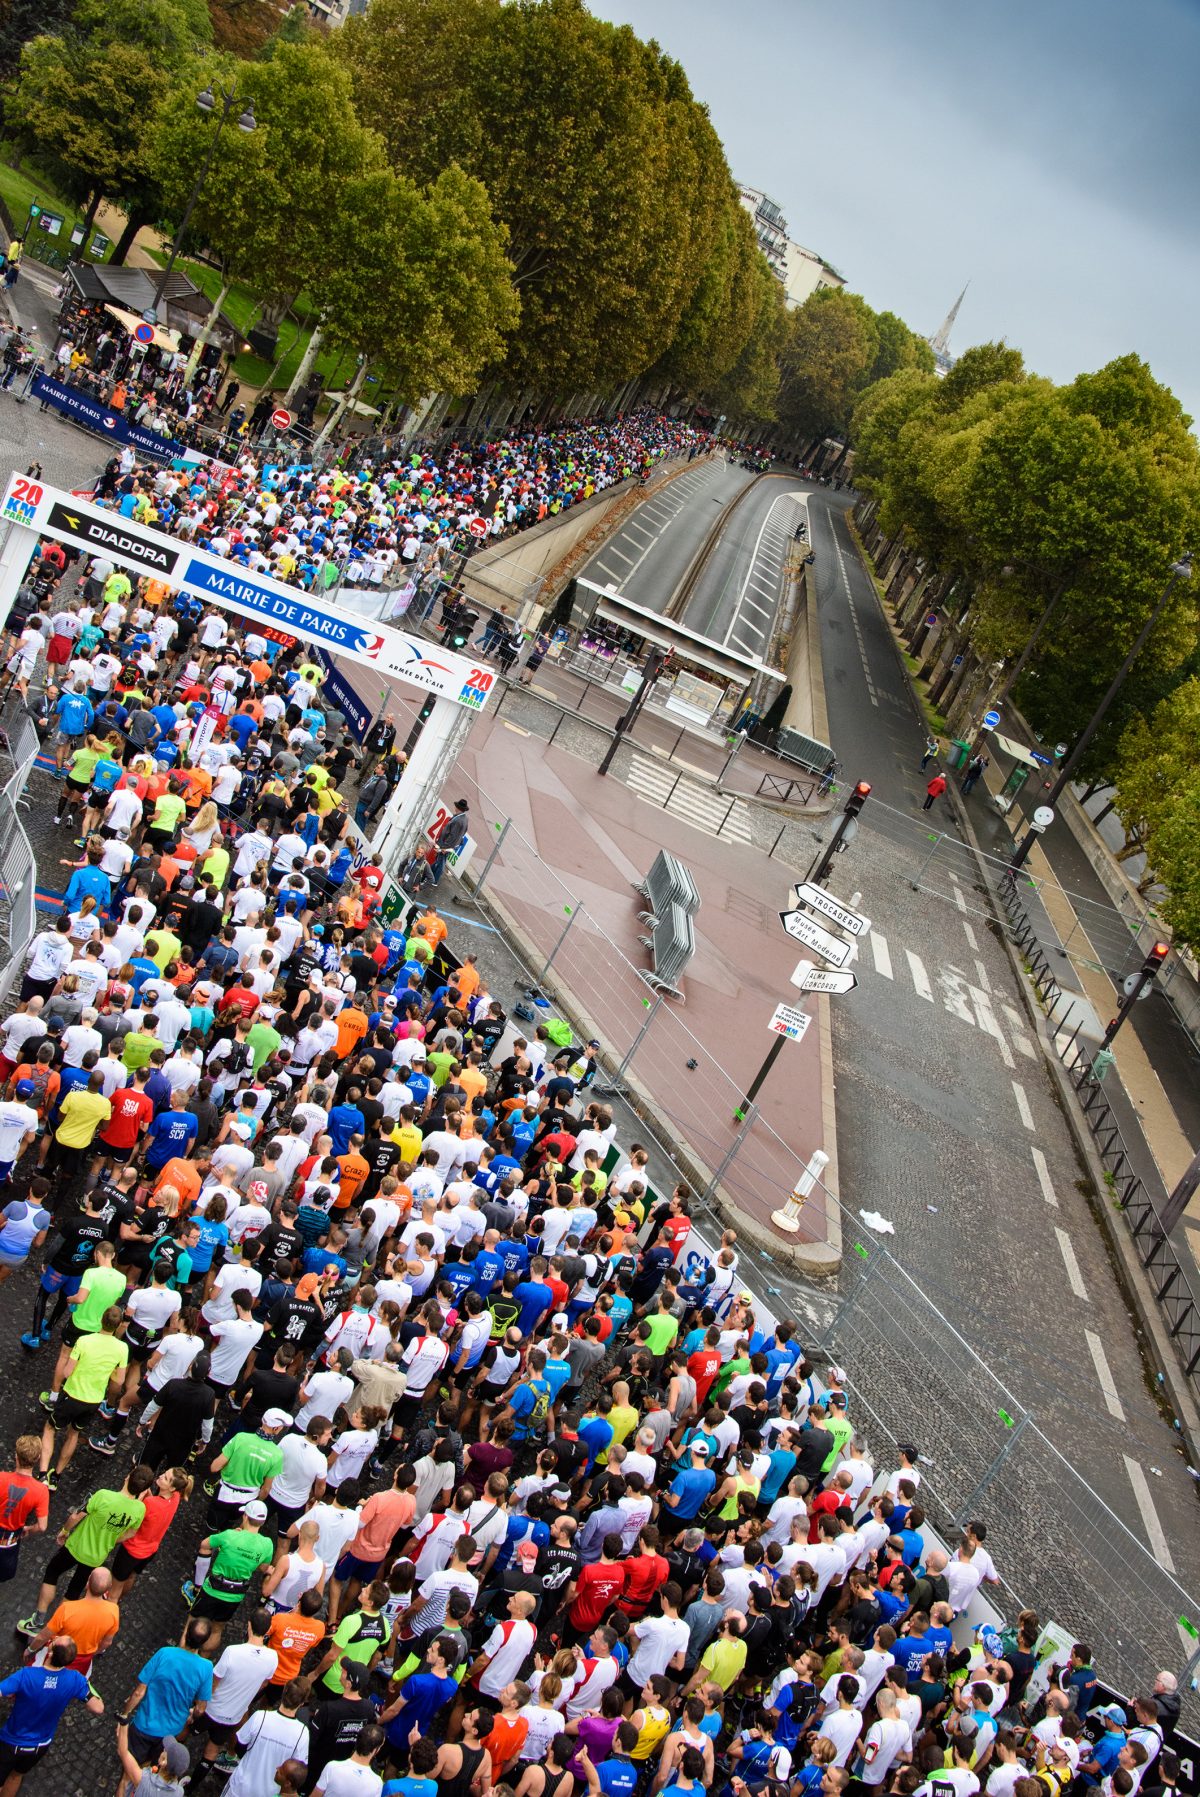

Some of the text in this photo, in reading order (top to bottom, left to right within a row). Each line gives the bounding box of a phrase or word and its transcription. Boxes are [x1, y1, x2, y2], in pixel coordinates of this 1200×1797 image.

[40, 383, 101, 420] MAIRIE DE PARIS
[127, 430, 153, 447] MAIRIE
[153, 443, 165, 454] DE
[11, 479, 43, 506] 20
[3, 509, 32, 526] PARIS
[6, 497, 37, 519] KM
[88, 524, 168, 567] DIADORA
[206, 573, 348, 640] MAIRIE DE PARIS
[414, 672, 424, 681] DE
[425, 677, 444, 690] L'AIR
[465, 668, 493, 692] 20
[457, 695, 482, 709] PARIS
[460, 684, 487, 703] KM
[1057, 744, 1067, 753] BUS
[387, 887, 397, 903] Bio
[813, 895, 859, 930] TROCADÉRO
[793, 915, 817, 935] Musée
[789, 925, 841, 963] d'Art Moderne
[804, 980, 838, 991] CONCORDE
[808, 972, 827, 981] ALMA
[774, 1021, 788, 1033] 20
[786, 1026, 799, 1035] KM
[171, 1121, 188, 1129] Team
